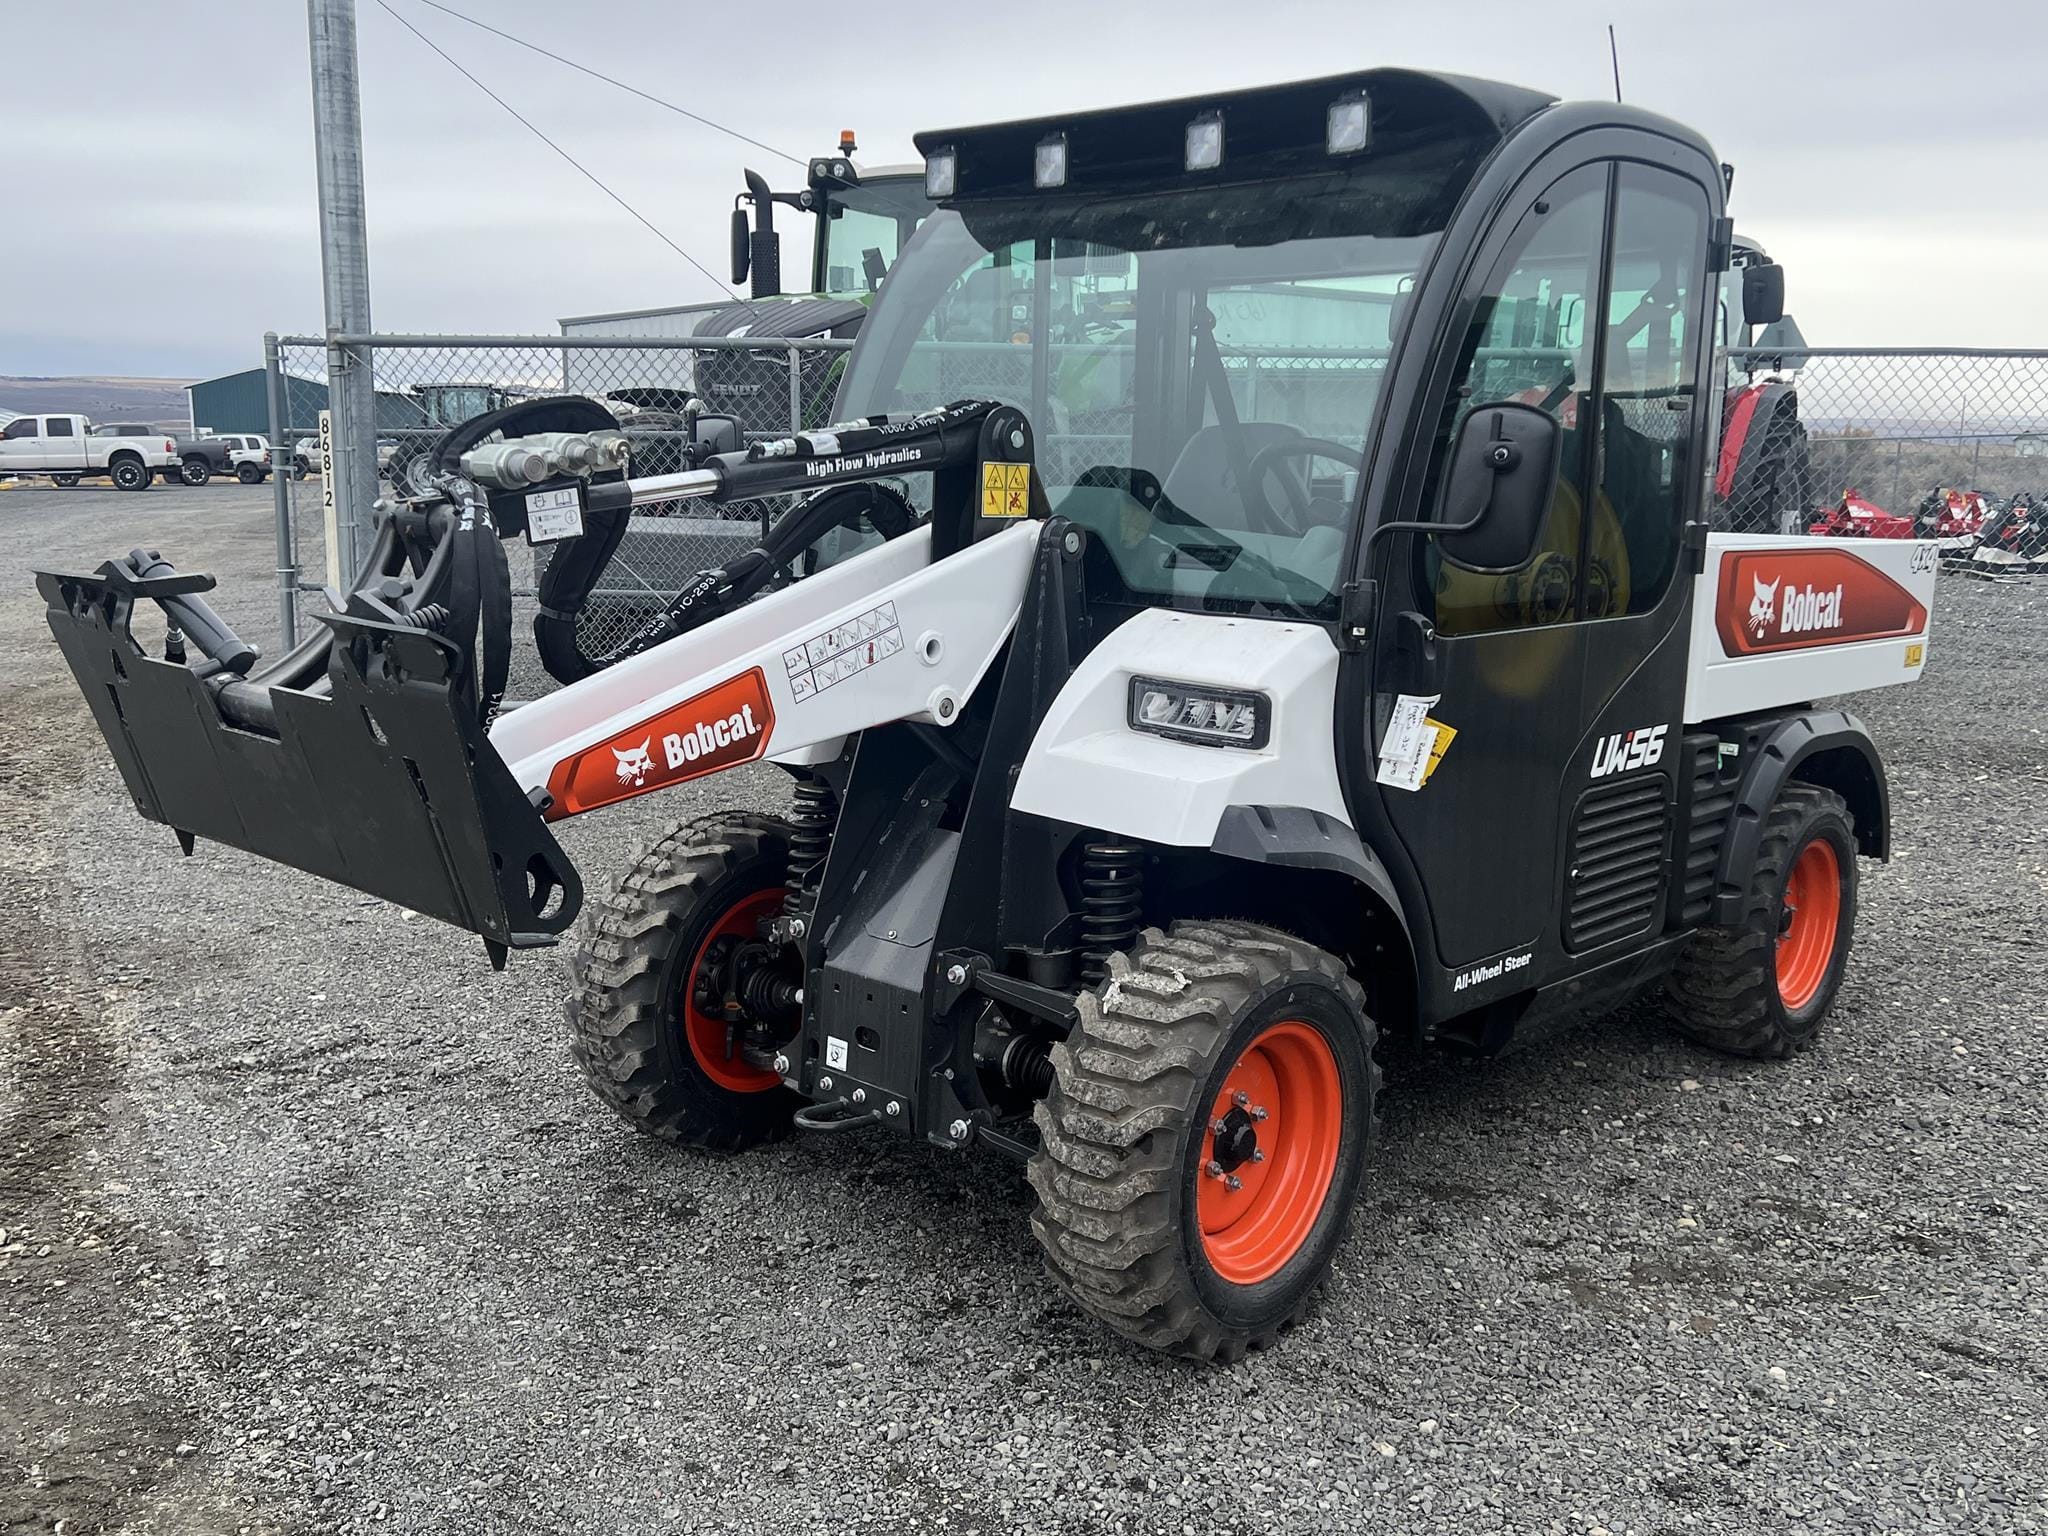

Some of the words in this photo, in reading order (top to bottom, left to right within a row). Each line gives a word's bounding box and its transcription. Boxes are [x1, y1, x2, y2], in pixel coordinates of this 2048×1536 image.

[711, 383, 761, 396] FENDT
[321, 418, 333, 507] 86812
[806, 459, 833, 477] High
[835, 458, 863, 472] Flow
[865, 448, 921, 469] Hydraulics
[1911, 544, 1939, 574] 4x4
[1780, 584, 1842, 634] Bobcat
[662, 703, 757, 770] Bobcat
[1590, 724, 1669, 779] UW56
[1453, 960, 1503, 992] All-Wheel
[1504, 952, 1532, 972] Steer
